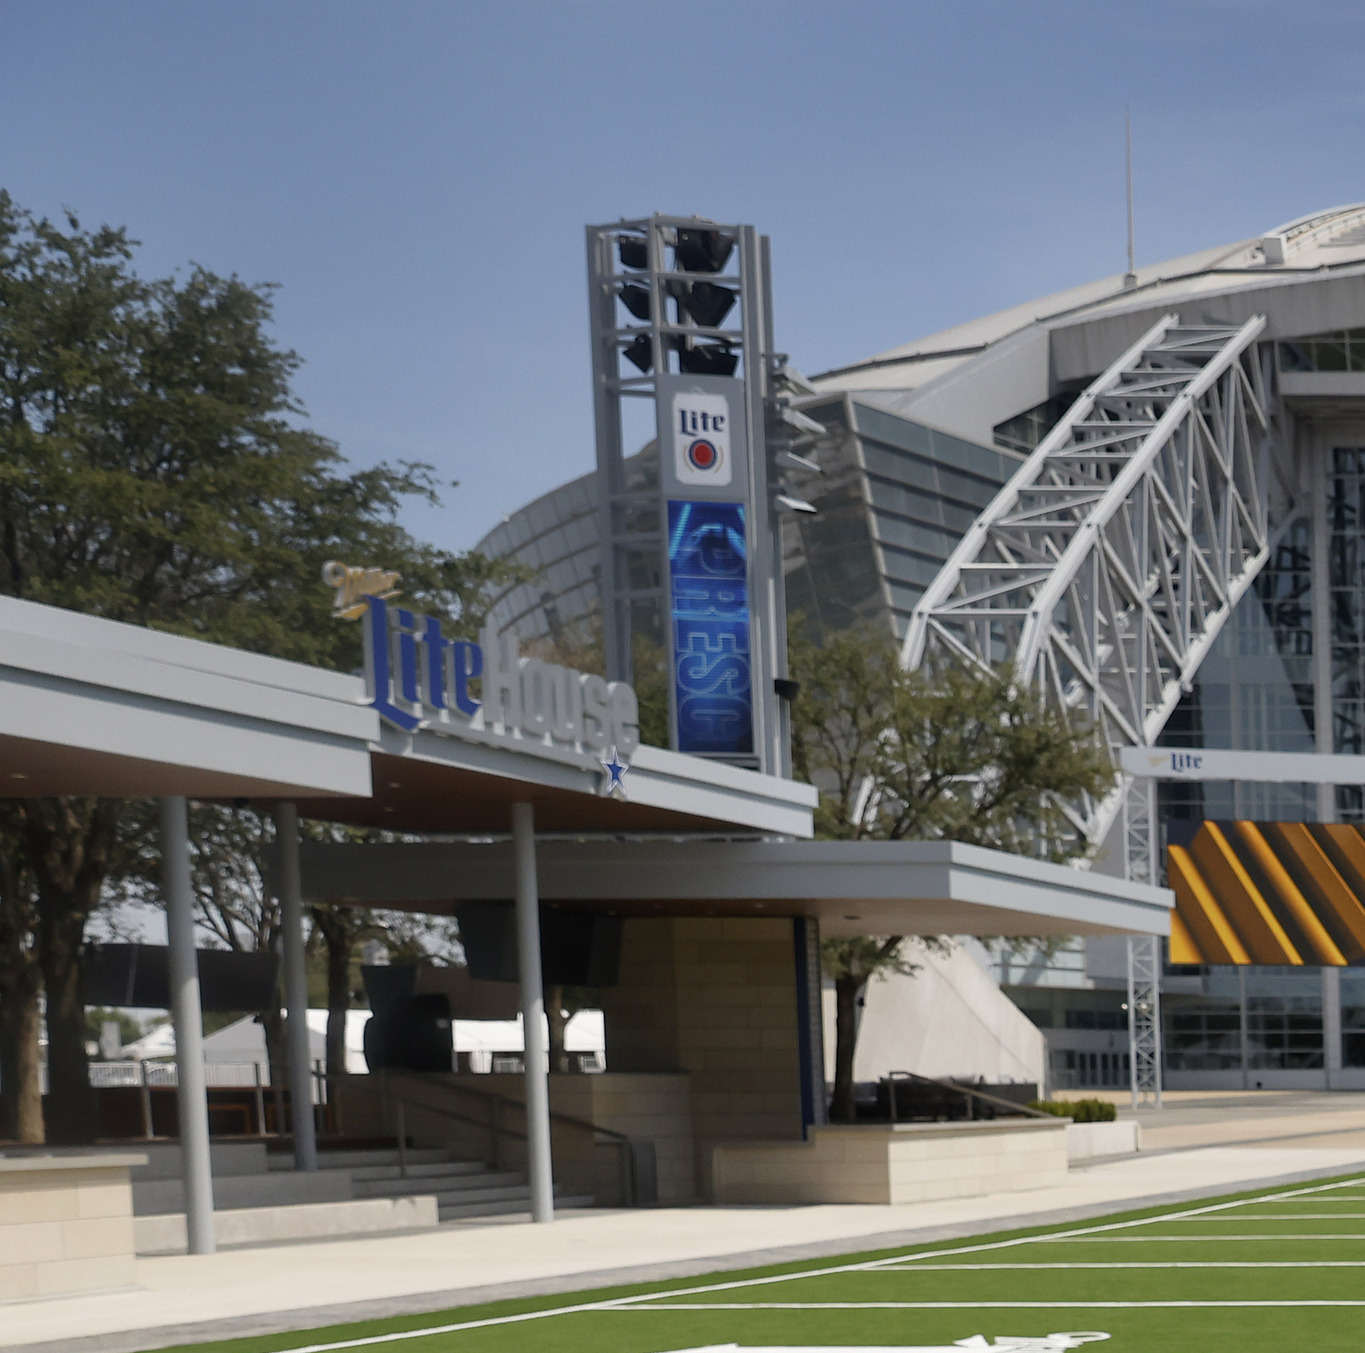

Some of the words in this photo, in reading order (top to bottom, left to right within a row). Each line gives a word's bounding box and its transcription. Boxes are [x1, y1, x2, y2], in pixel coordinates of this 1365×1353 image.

[678, 408, 727, 436] Lite
[362, 594, 484, 731] Lite
[481, 612, 640, 750] House
